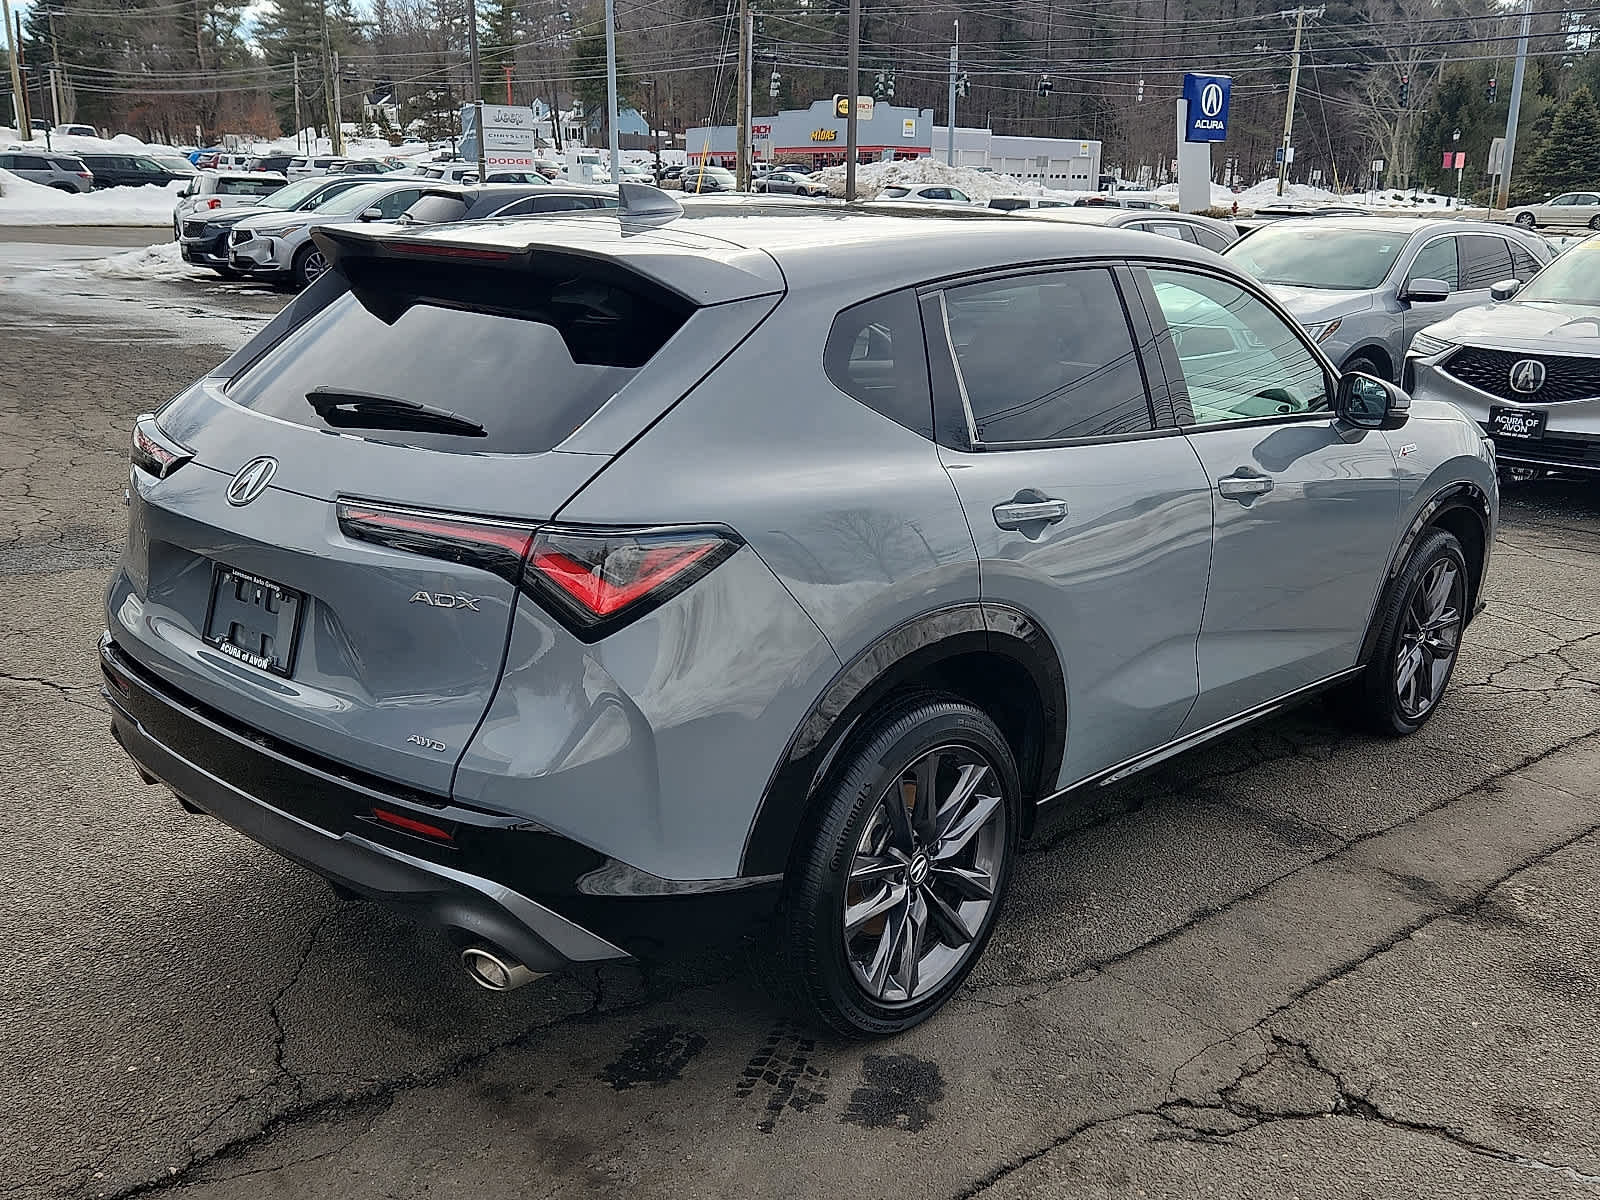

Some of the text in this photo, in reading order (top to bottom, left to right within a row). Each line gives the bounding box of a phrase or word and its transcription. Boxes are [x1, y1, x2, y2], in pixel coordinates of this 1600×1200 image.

[494, 109, 523, 126] Jeep
[1195, 119, 1224, 129] ACURA
[488, 157, 532, 165] DODGE
[1495, 416, 1539, 427] ACURA OF
[1502, 424, 1527, 432] AVON
[408, 590, 481, 611] ADX
[220, 643, 240, 659] ACURA
[249, 655, 268, 670] AVON
[407, 734, 446, 752] AWD
